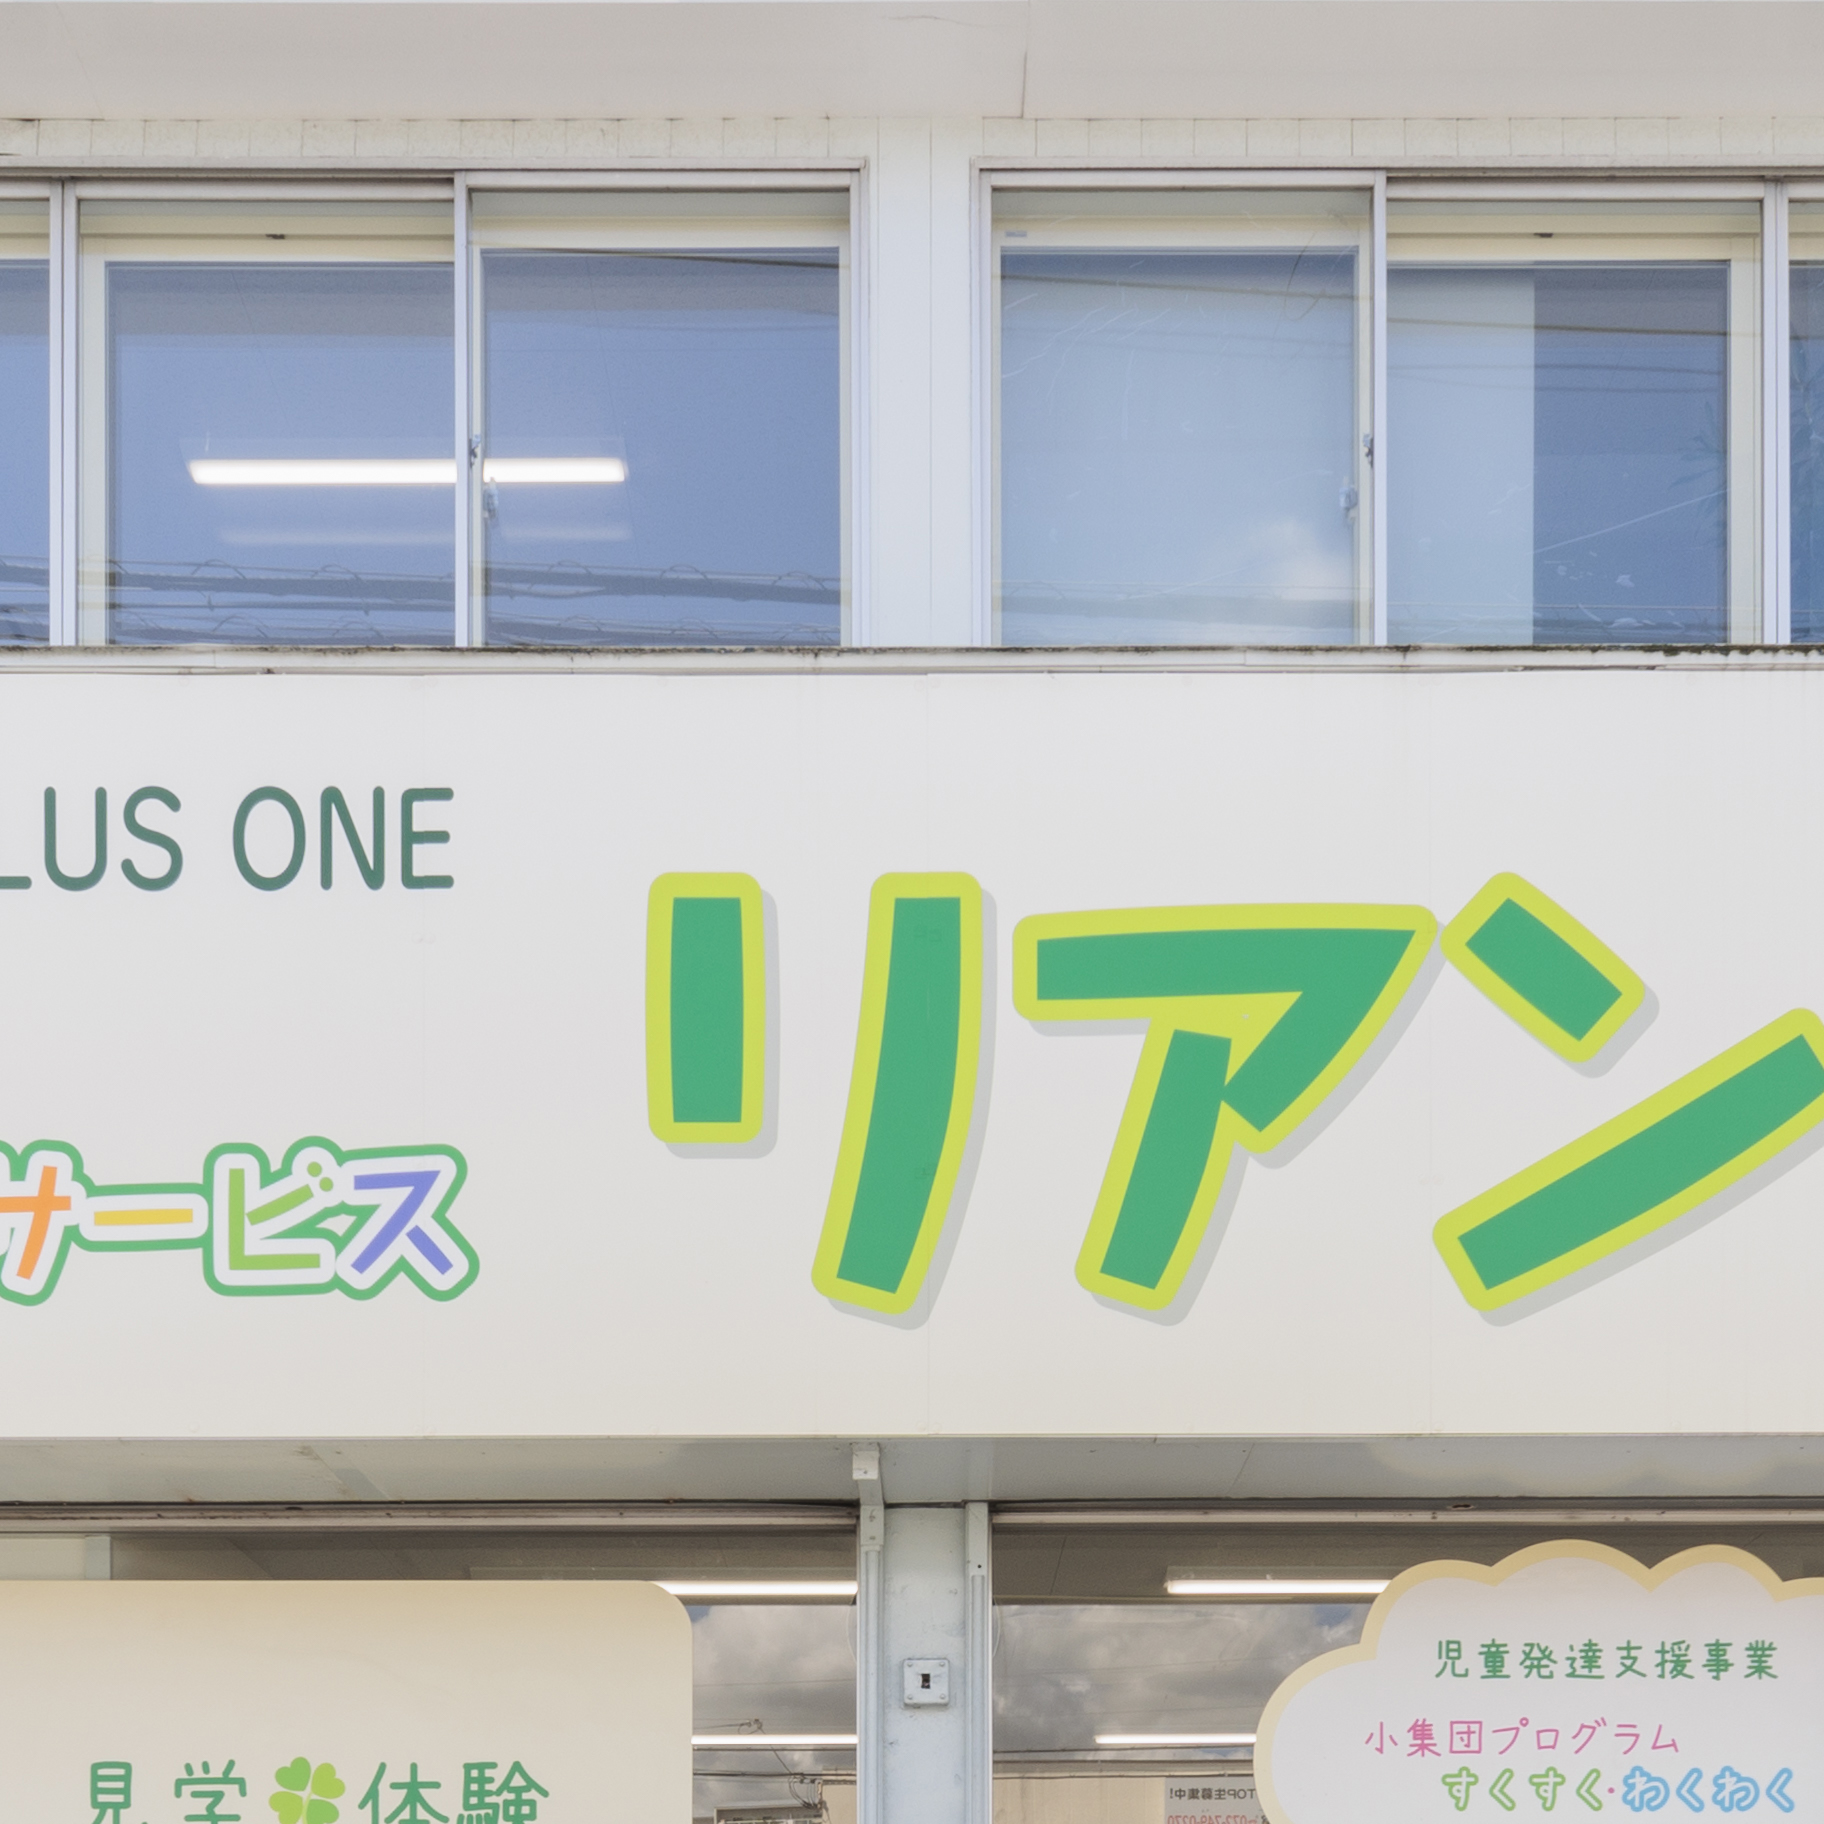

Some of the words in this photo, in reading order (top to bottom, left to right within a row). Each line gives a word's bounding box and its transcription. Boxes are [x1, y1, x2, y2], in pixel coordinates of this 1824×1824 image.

[232, 785, 455, 891] ONE
[1434, 1638, 1780, 1683] 児童発達支援事業
[1364, 1718, 1681, 1758] 小集団プログラム
[1441, 1766, 1795, 1813] すくすく・わくわく
